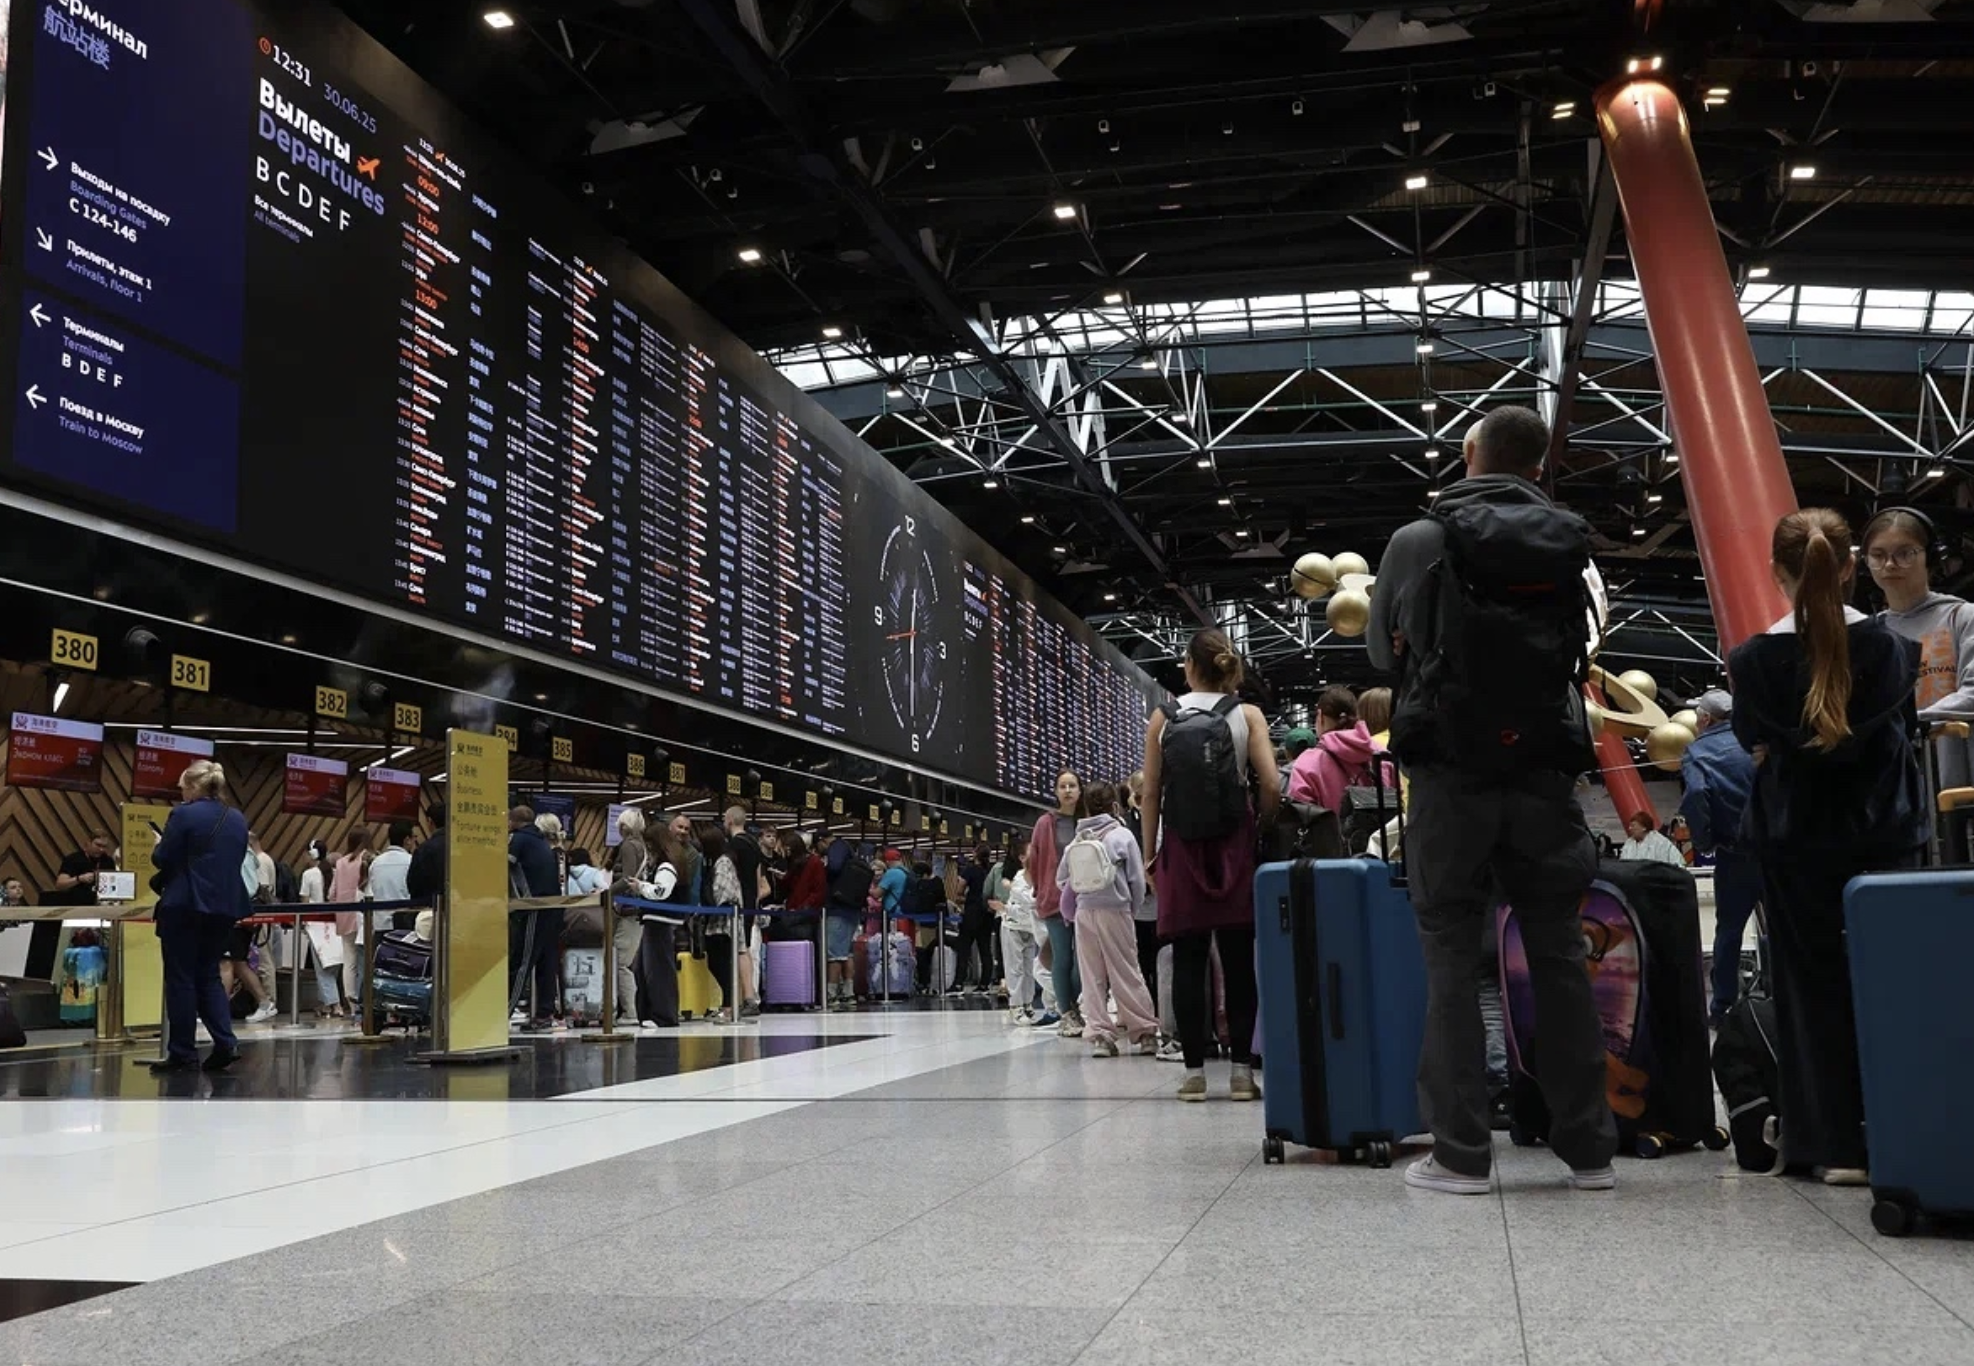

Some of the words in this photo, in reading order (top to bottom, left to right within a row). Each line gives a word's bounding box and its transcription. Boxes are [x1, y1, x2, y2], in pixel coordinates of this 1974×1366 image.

[273, 44, 312, 88] 12:31
[323, 82, 377, 134] 30.06.25
[260, 77, 350, 164] Вылеты
[258, 109, 385, 215] Departures
[71, 161, 113, 194] Выходы
[115, 187, 128, 202] на
[256, 155, 270, 182] B
[276, 171, 290, 197] C
[298, 182, 313, 208] D
[319, 196, 331, 222] E
[339, 208, 351, 231] F
[69, 197, 80, 213] C
[83, 203, 137, 243] 124-146
[70, 180, 117, 215] Boarding
[119, 207, 147, 230] Gates
[66, 259, 109, 288] Arrivals,
[110, 278, 135, 298] floor
[67, 239, 118, 274] Прилеты,
[145, 278, 152, 290] 1
[63, 316, 124, 352] Терминалы
[63, 335, 113, 365] Terminals
[62, 352, 71, 368] B
[80, 360, 90, 375] D
[97, 367, 106, 382] E
[113, 374, 123, 388] F
[58, 415, 85, 434] Train
[88, 425, 100, 439] to
[101, 433, 143, 454] Moscow
[60, 396, 94, 421] Поезд
[105, 414, 144, 439] Москву
[874, 606, 883, 626] 9
[55, 635, 95, 664] 380
[939, 641, 947, 660] 3
[174, 660, 206, 686] 381
[318, 690, 344, 714] 382
[396, 707, 420, 727] 383
[554, 741, 571, 759] 385
[911, 733, 920, 752] 6
